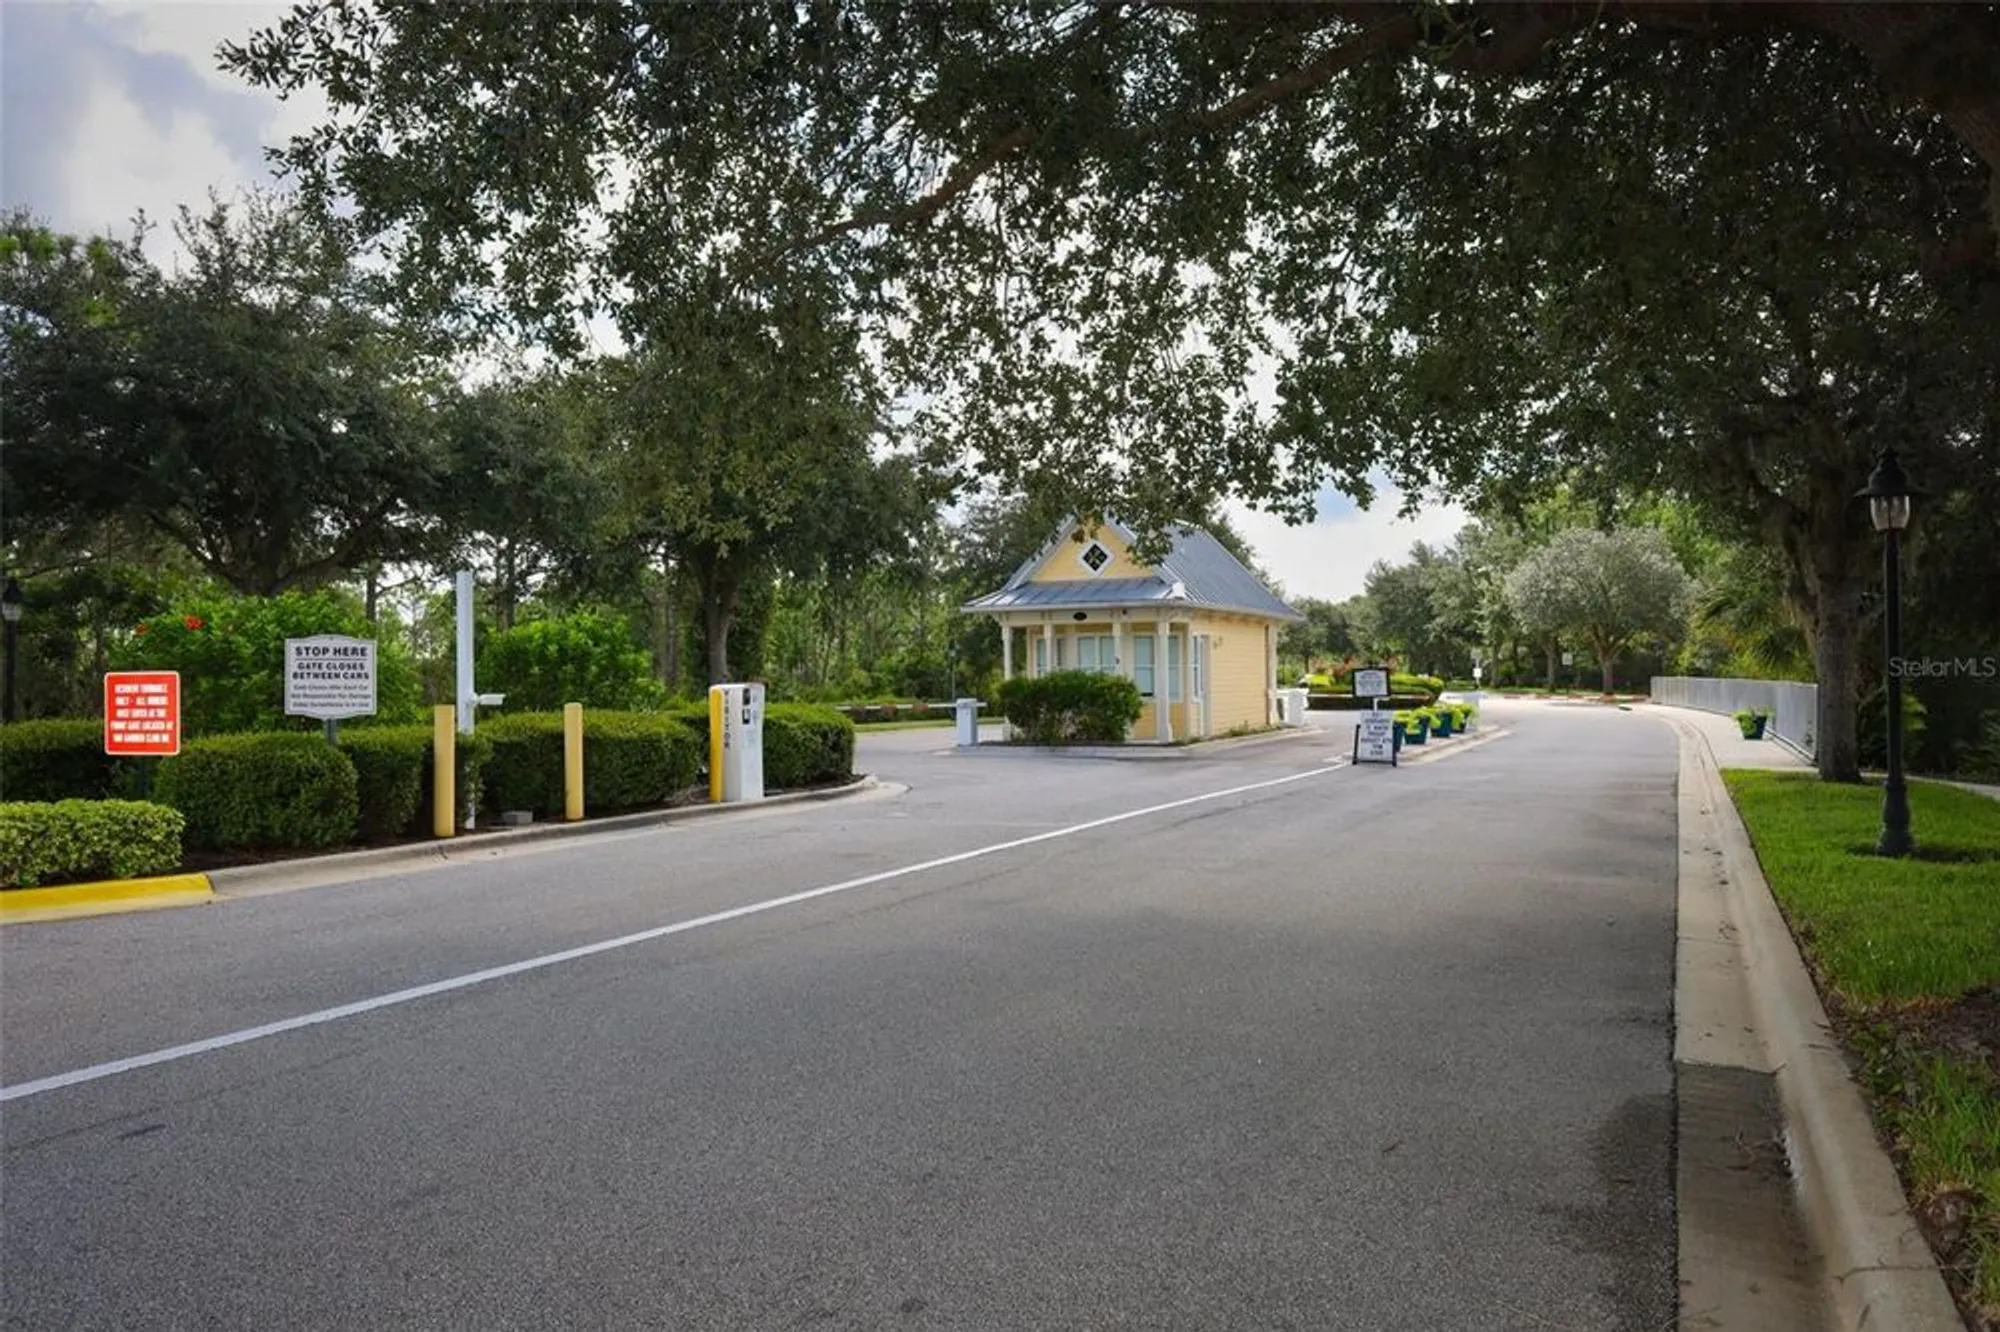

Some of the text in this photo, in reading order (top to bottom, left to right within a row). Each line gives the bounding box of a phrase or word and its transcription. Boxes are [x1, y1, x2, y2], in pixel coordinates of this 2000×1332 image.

[295, 646, 368, 657] STOP HERE
[297, 662, 365, 671] GATE CLOSES
[292, 672, 369, 680] BETWEEN CARS
[723, 688, 731, 750] VISITOR
